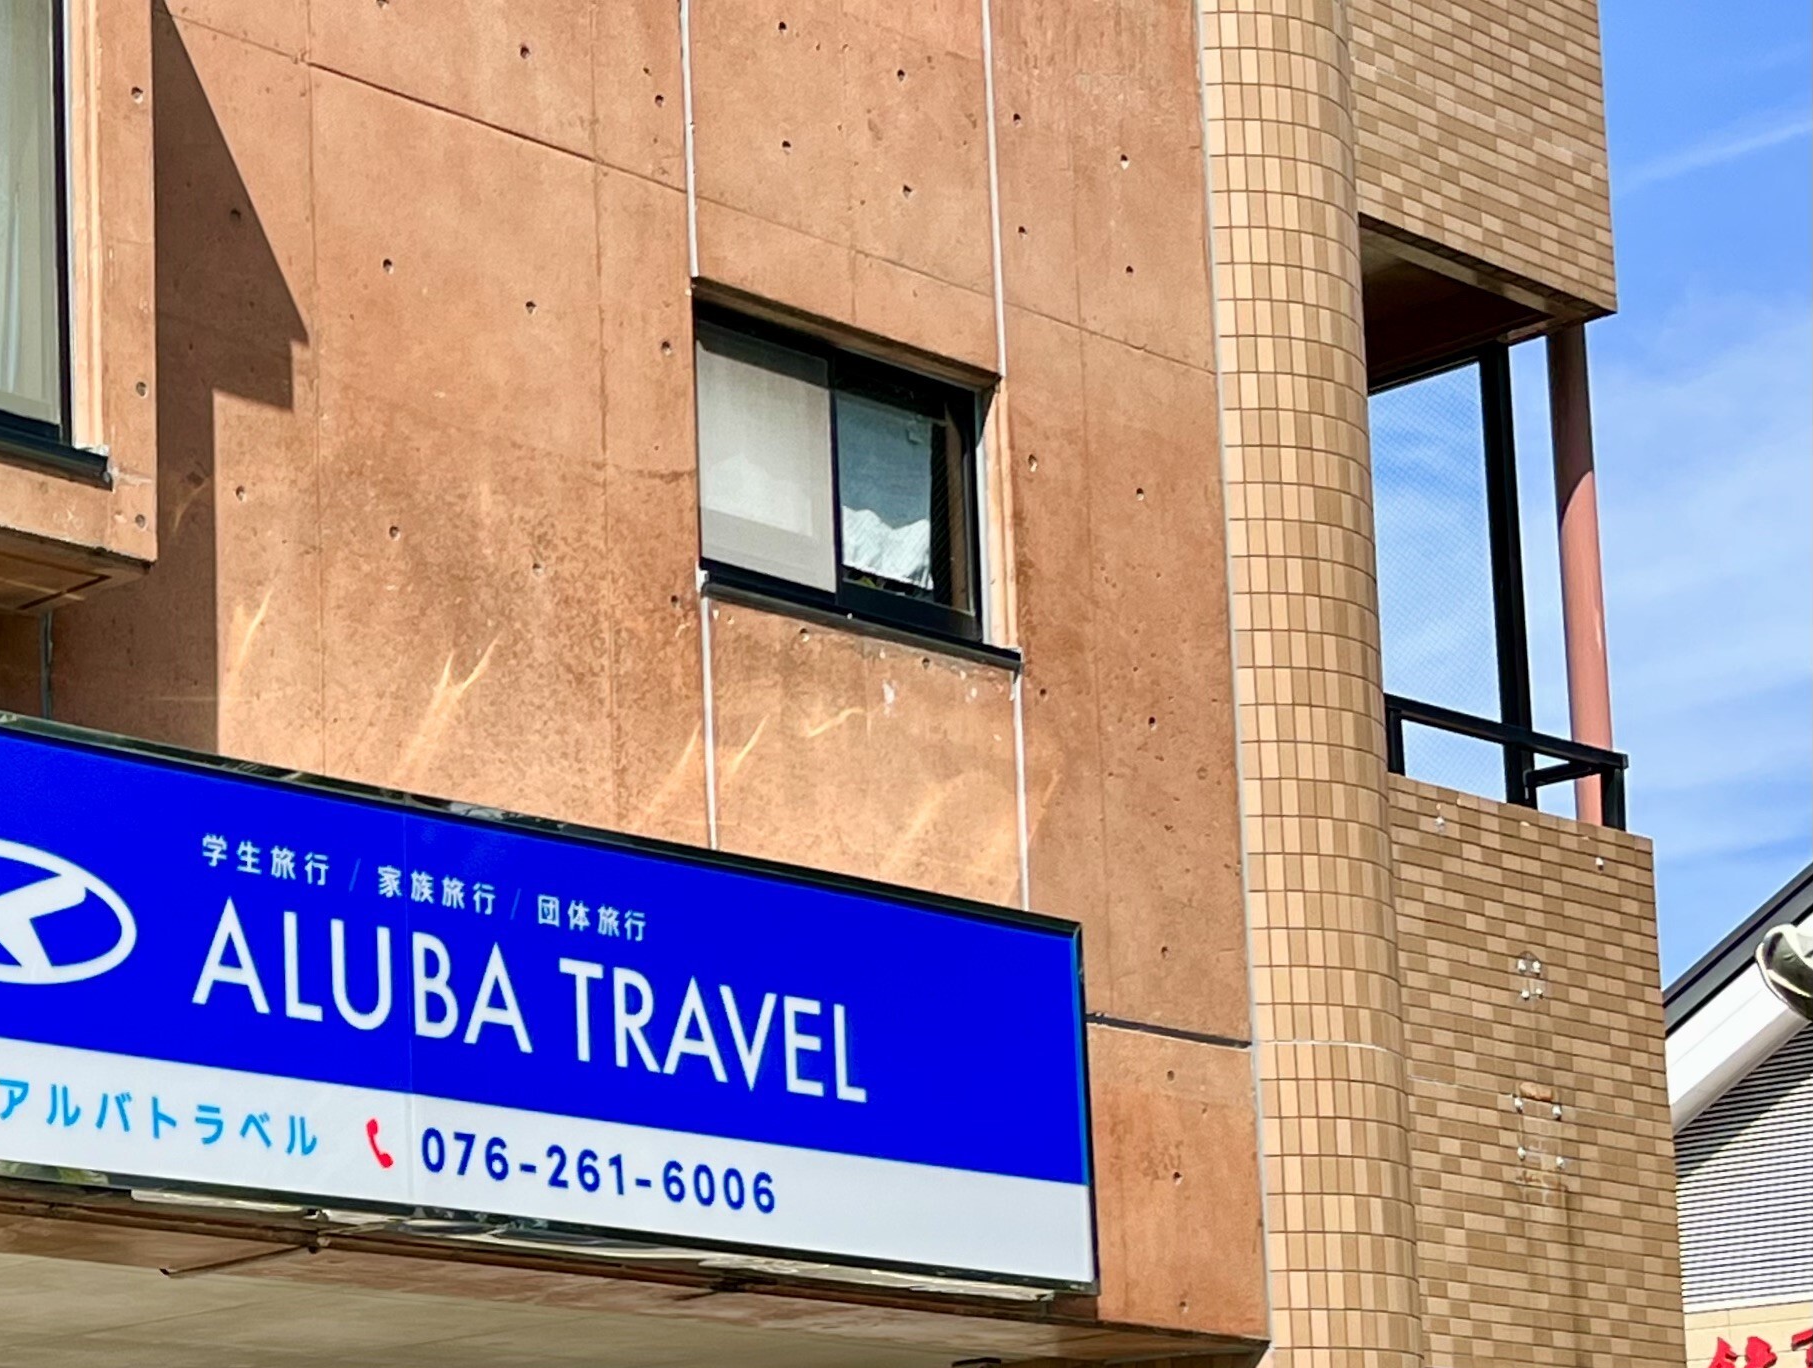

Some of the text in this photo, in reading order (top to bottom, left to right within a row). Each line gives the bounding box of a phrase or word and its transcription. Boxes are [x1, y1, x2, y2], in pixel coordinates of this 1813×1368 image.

[201, 833, 647, 942] 学生旅行 家族旅行 団体旅行
[192, 897, 867, 1104] ALUBA TRAVEL
[421, 1126, 776, 1215] 076-261-6006
